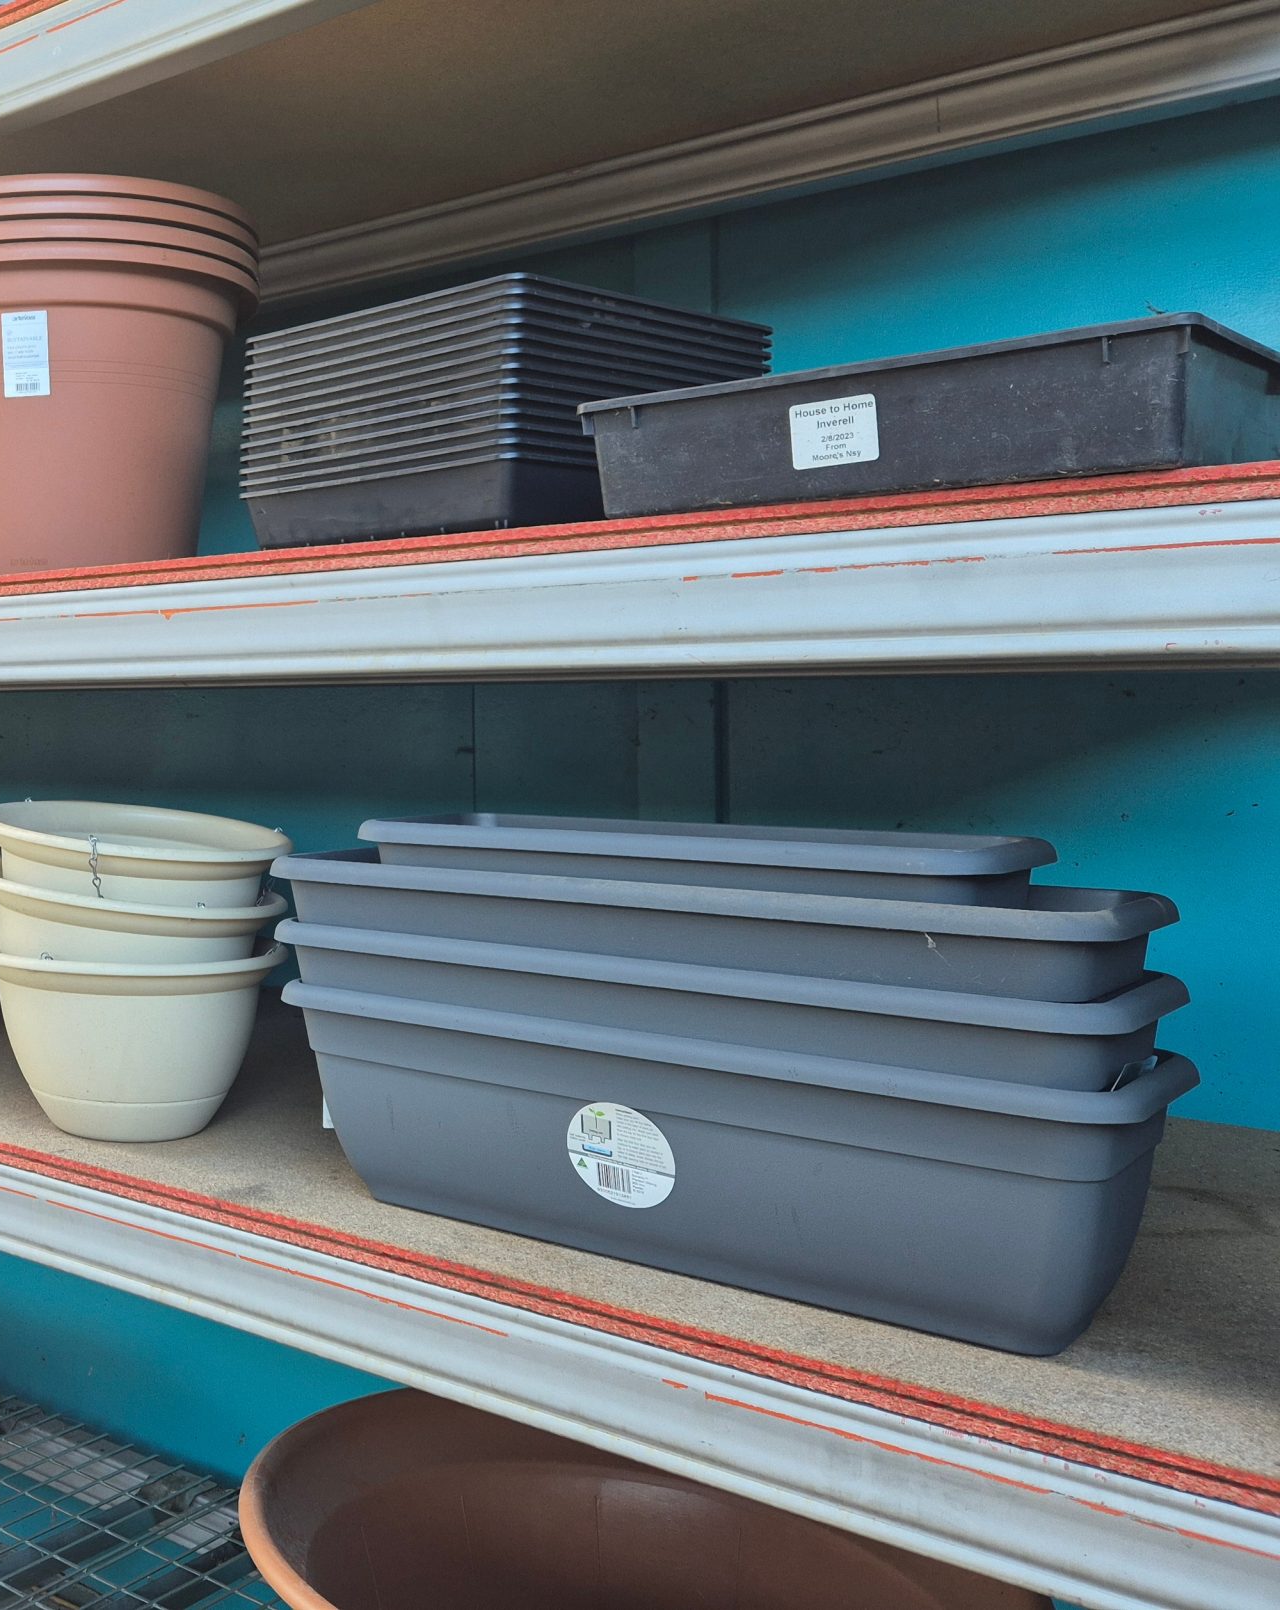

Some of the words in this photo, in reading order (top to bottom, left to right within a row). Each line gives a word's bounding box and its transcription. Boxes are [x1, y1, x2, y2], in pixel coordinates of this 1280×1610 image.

[795, 408, 827, 419] House
[830, 406, 840, 414] to
[843, 401, 874, 411] Home
[817, 416, 854, 429] Inverell
[821, 432, 854, 443] 2/8/2023
[846, 450, 862, 458] Nsy
